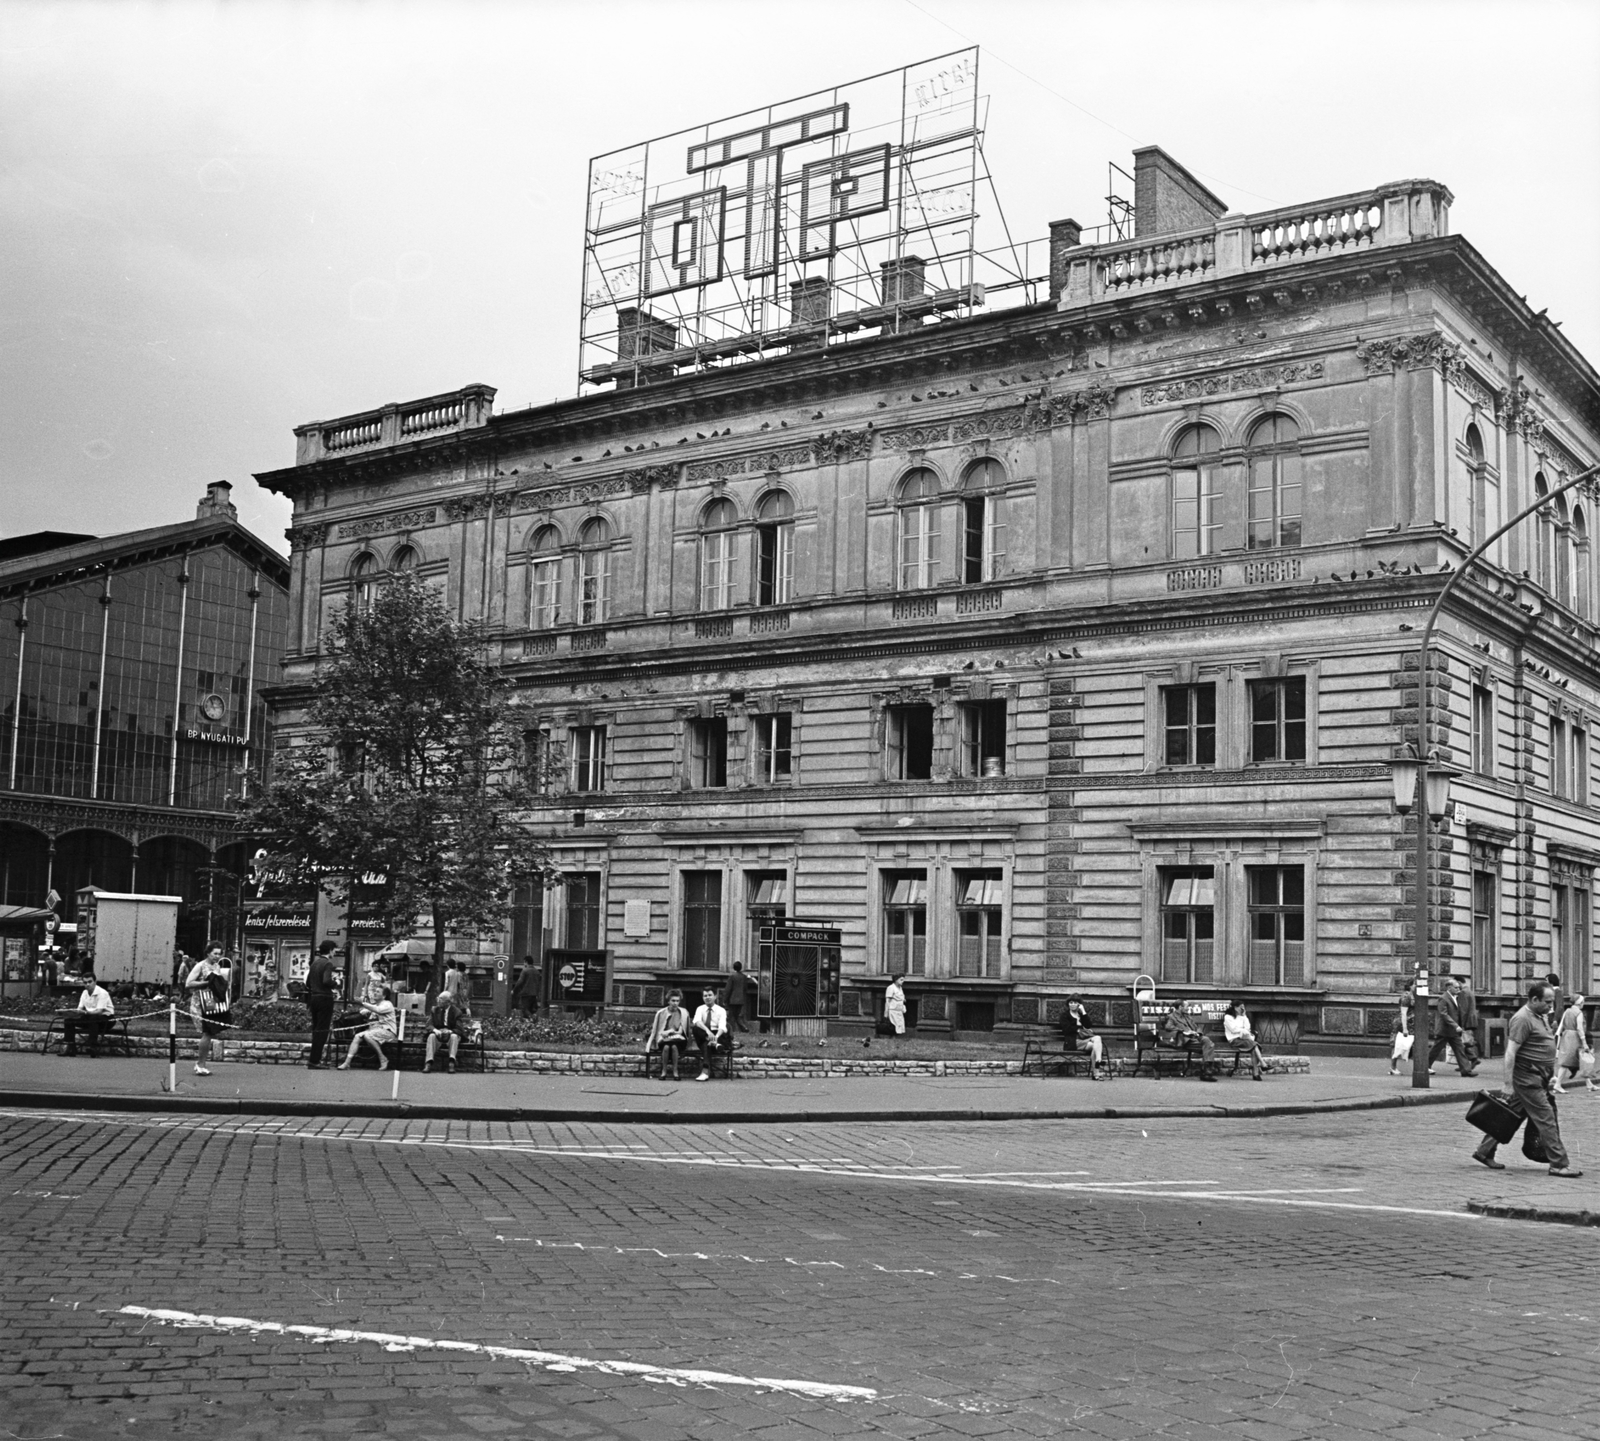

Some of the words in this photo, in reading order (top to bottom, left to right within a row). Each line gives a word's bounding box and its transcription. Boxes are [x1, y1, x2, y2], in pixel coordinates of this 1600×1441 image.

[643, 102, 892, 298] OTP
[201, 731, 234, 744] NYUGATI
[787, 931, 830, 941] COMPACK
[559, 972, 576, 981] STOP
